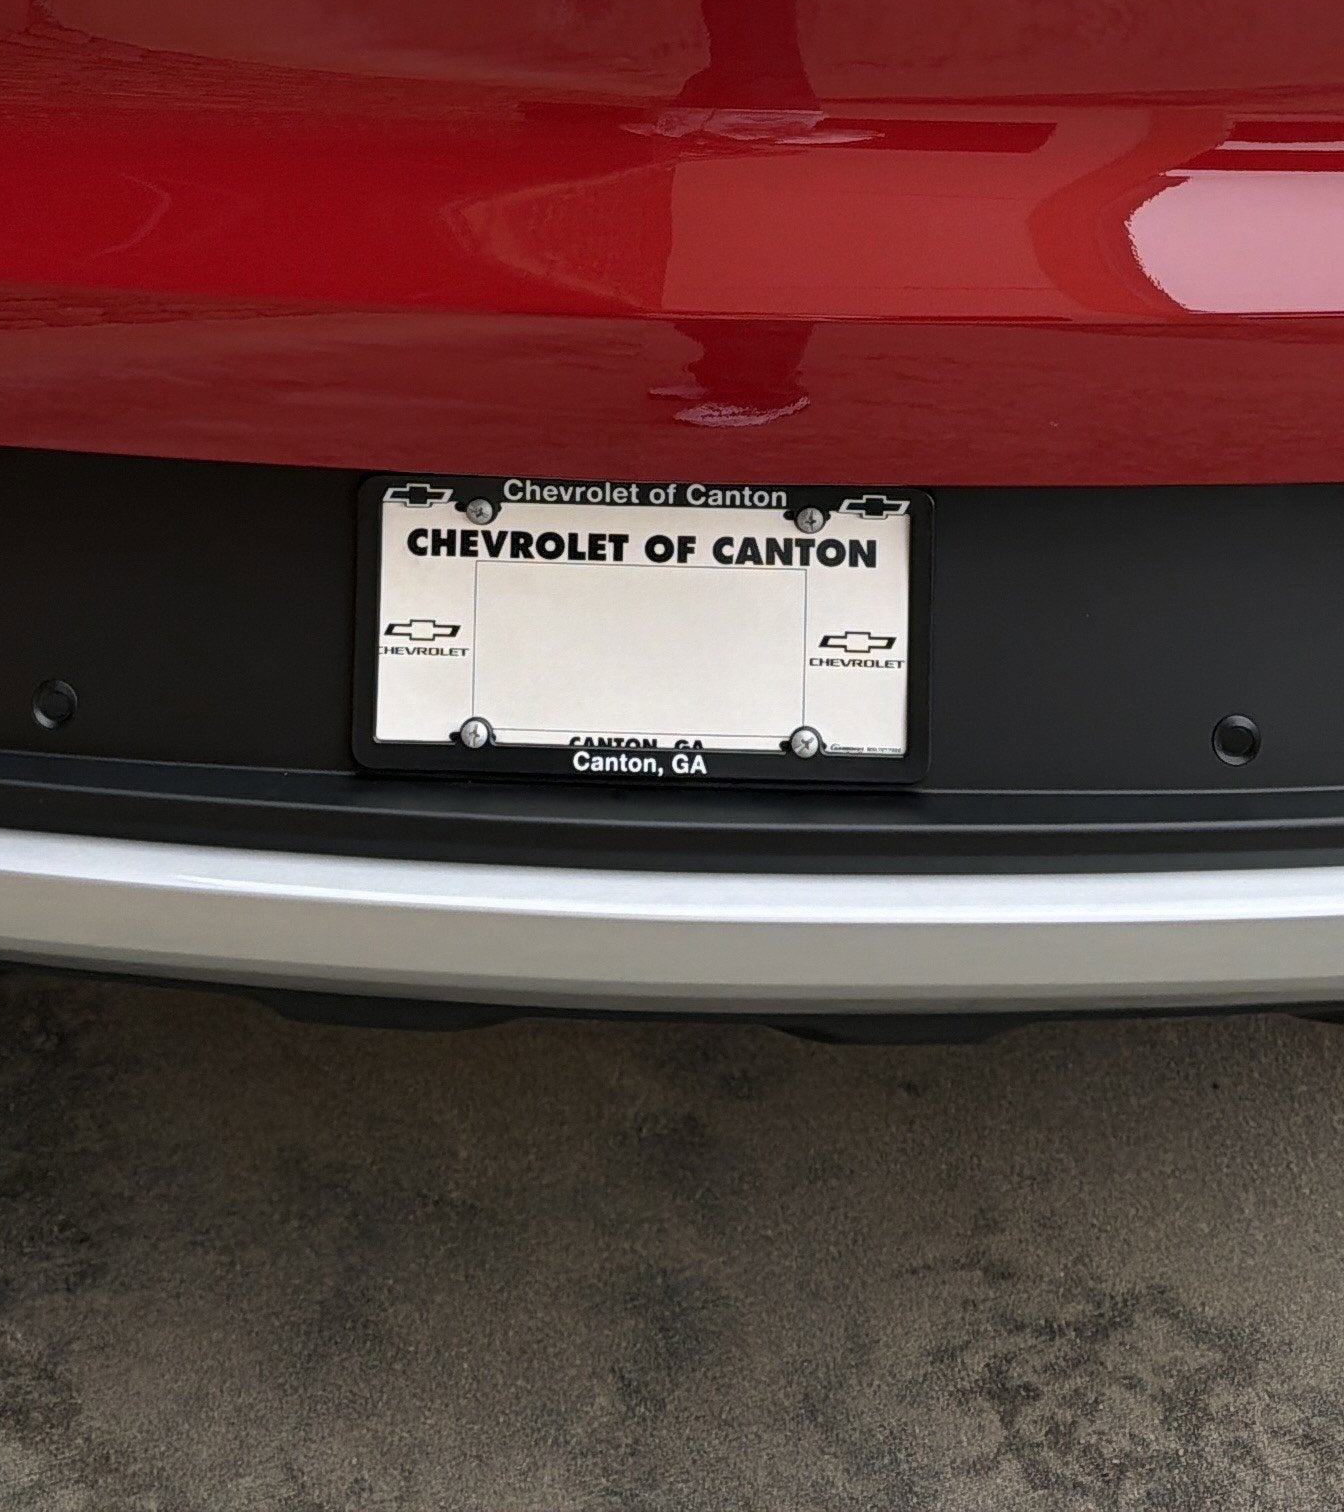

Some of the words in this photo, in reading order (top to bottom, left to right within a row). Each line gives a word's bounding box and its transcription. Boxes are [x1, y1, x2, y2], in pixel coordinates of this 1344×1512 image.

[503, 479, 639, 504] Chevrolet
[649, 482, 677, 505] of
[686, 485, 787, 507] Canton
[407, 528, 629, 562] CHEVROLET
[644, 535, 697, 564] OF
[713, 536, 877, 568] CANTON
[809, 657, 905, 669] CHEVROLET
[572, 750, 664, 777] Canton,
[671, 753, 708, 775] GA
